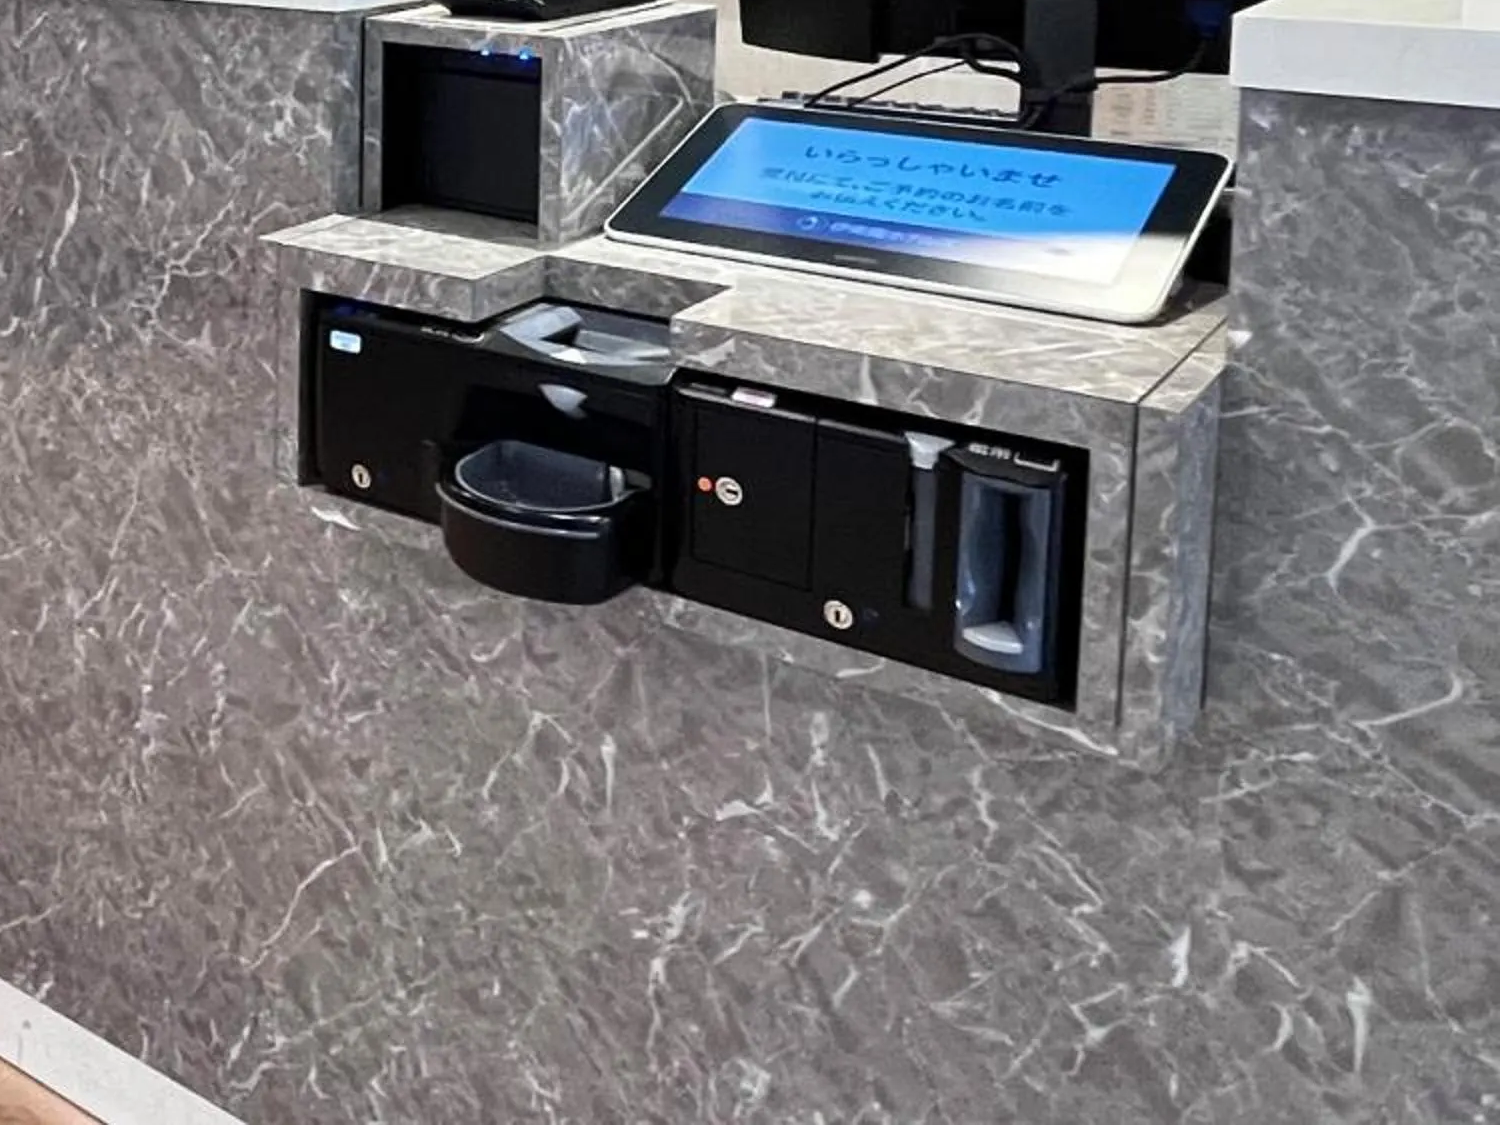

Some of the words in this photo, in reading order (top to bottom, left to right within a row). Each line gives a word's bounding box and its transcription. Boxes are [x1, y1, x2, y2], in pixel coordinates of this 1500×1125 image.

[805, 145, 1063, 188] いらっしゃいませ
